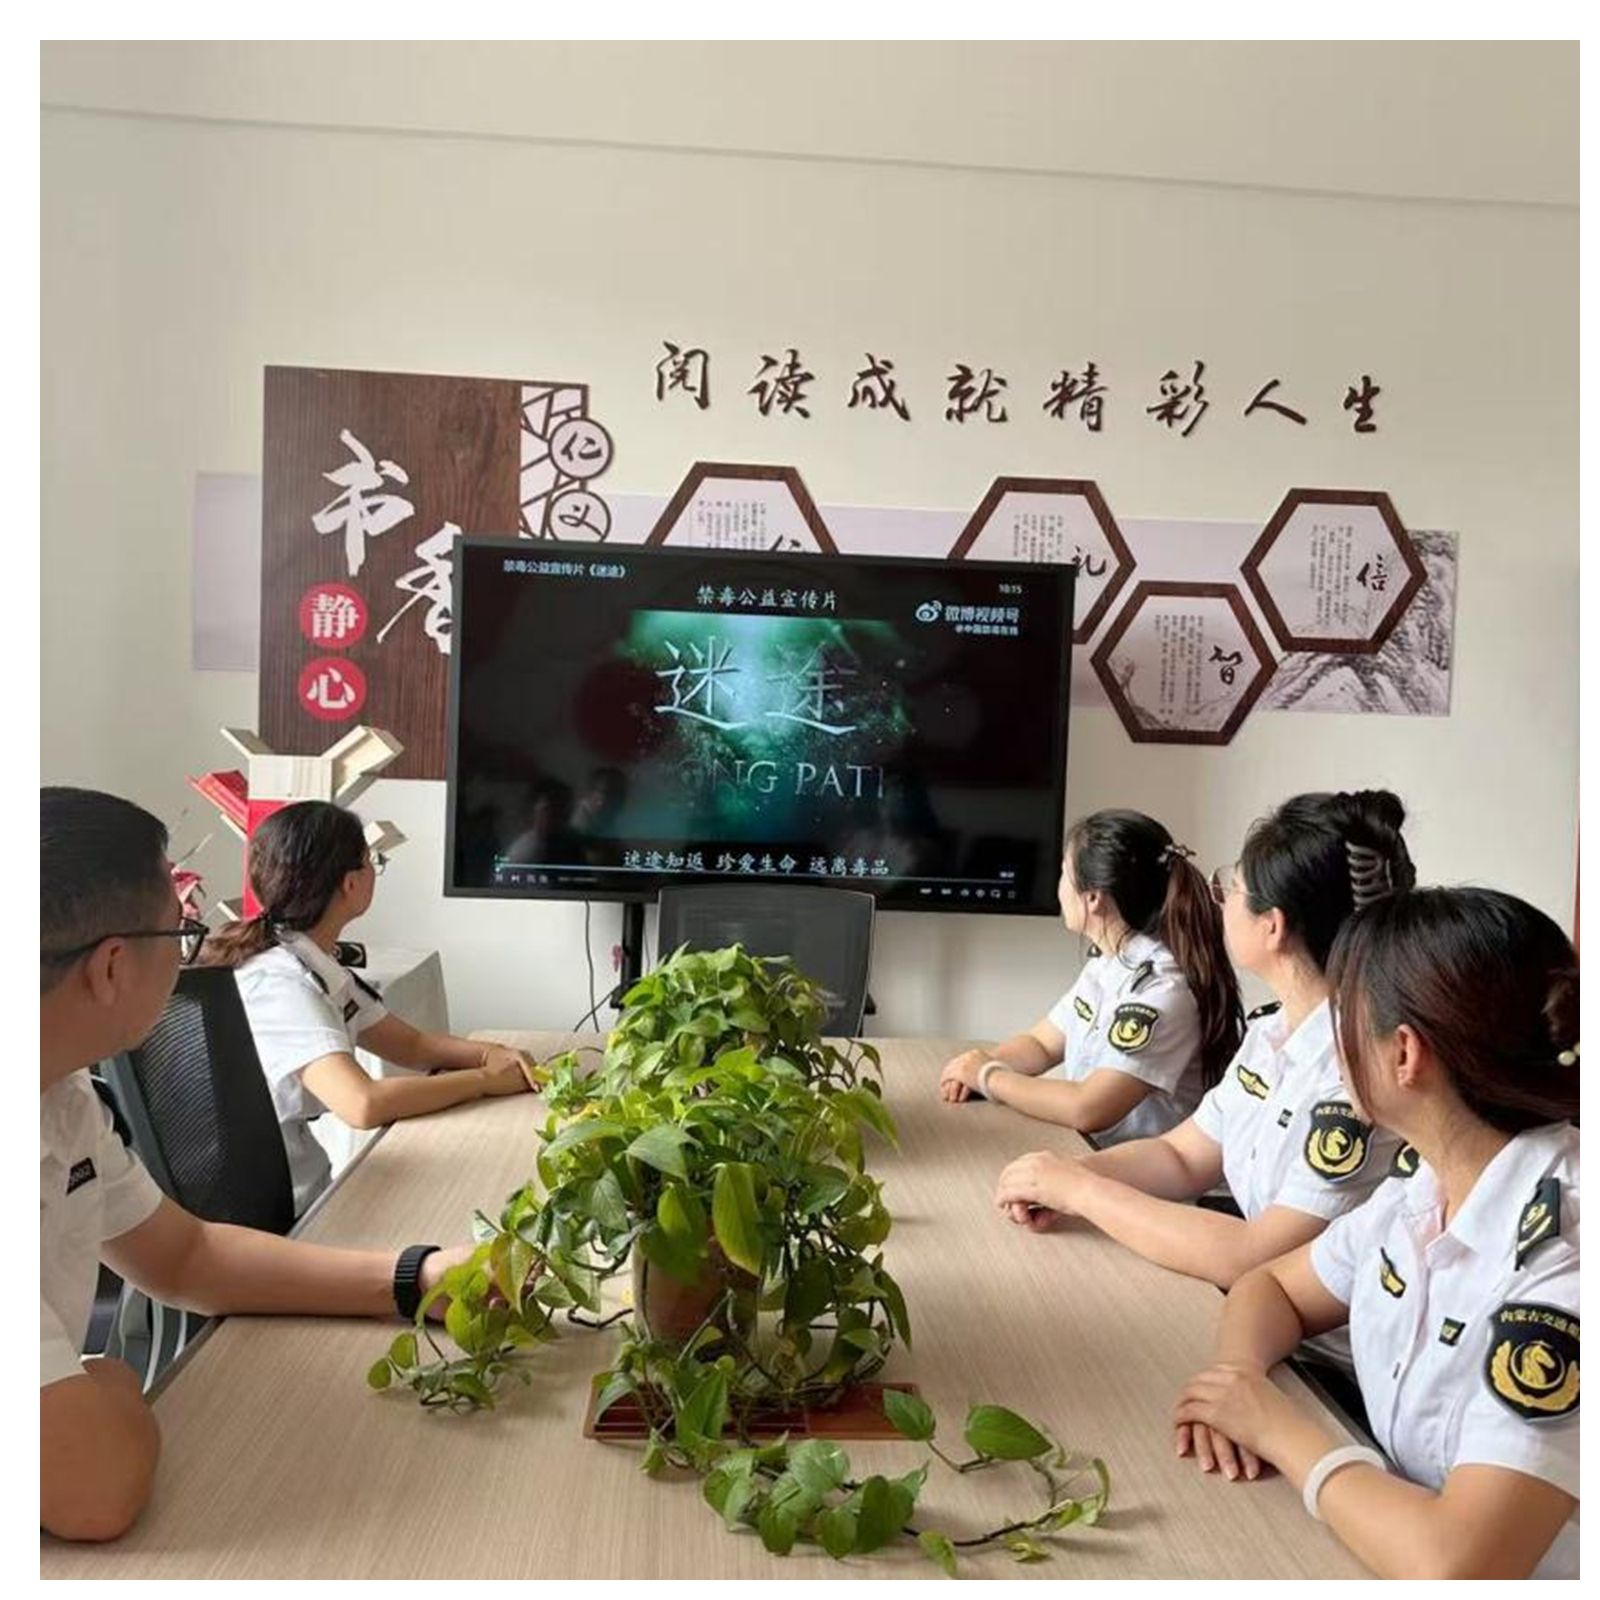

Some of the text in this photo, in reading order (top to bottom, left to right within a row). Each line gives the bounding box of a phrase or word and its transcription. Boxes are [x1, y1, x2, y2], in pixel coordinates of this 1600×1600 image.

[654, 341, 1386, 437] 阅读成就精彩人生
[697, 585, 838, 611] 禁毒公益宣传片
[655, 634, 858, 735] 迷途
[622, 850, 889, 877] 迷途知返 珍爱生命 远离毒品
